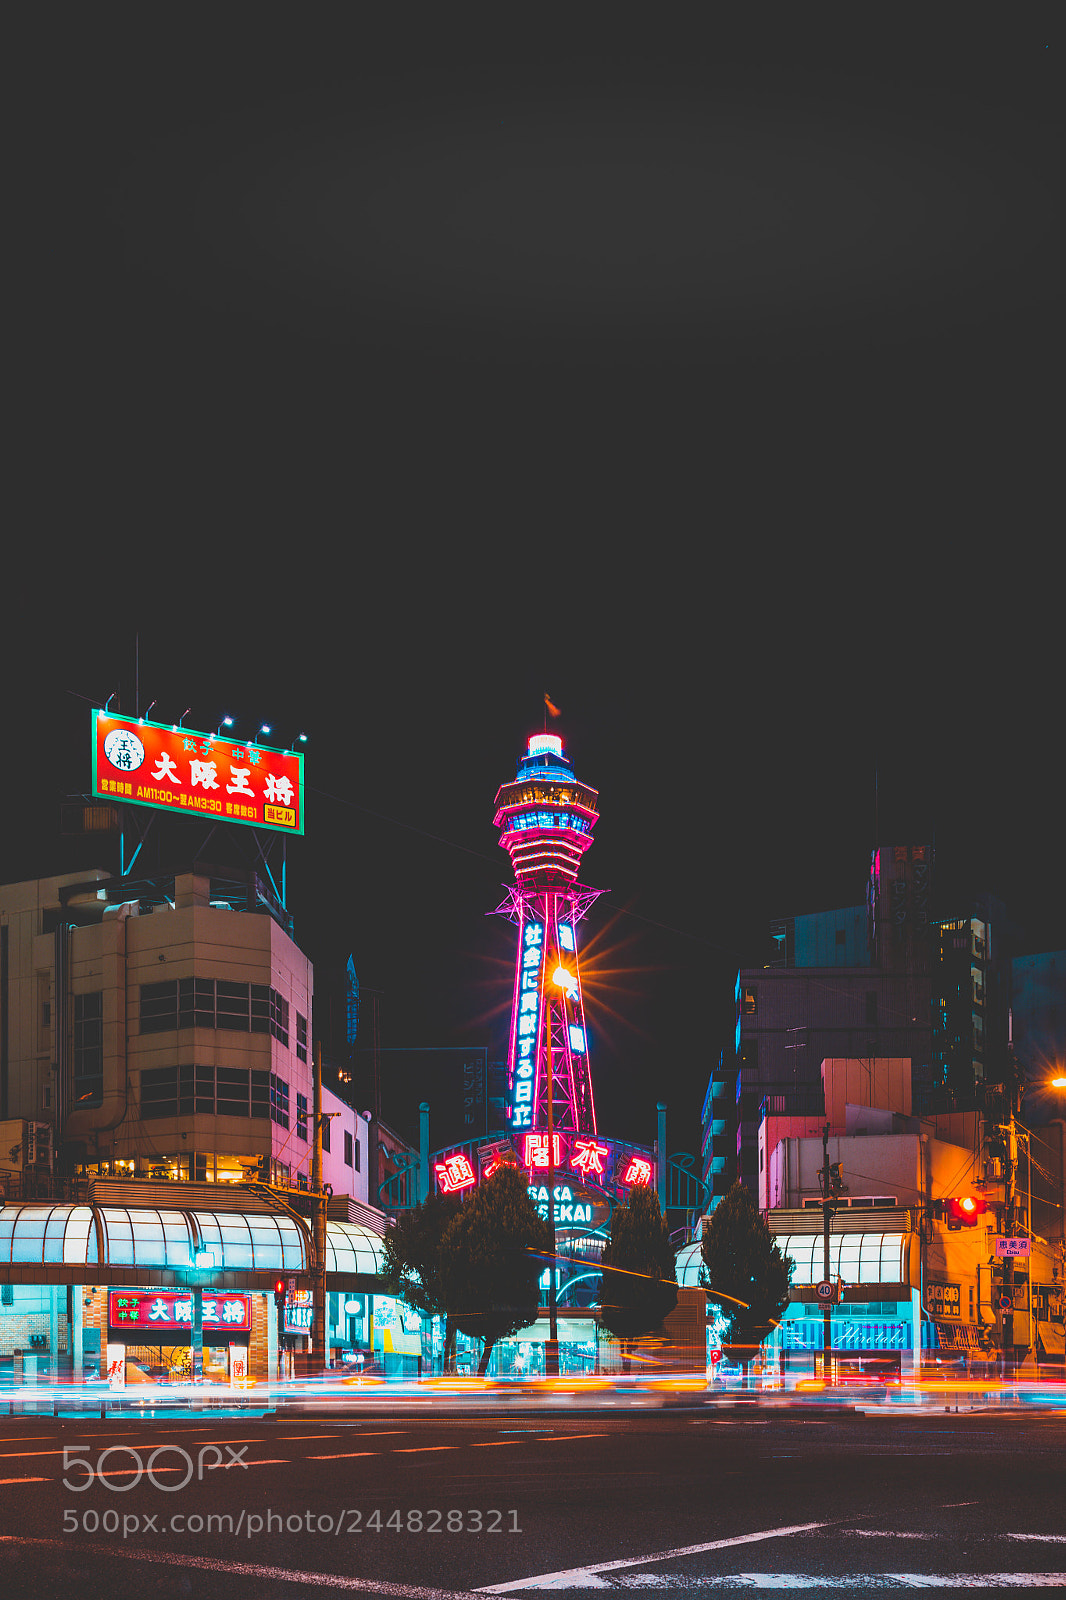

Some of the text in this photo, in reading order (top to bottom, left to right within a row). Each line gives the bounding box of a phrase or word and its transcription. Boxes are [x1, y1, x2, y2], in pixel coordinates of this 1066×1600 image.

[115, 739, 133, 769] 王将
[183, 737, 262, 766] 餃子 中華
[151, 751, 295, 805] 大阪王将
[101, 778, 132, 796] 営業時間
[226, 802, 257, 819] 客席数61
[267, 807, 293, 822] 当ビル
[117, 1298, 140, 1308] 餃子
[819, 1285, 831, 1295] 40
[148, 1298, 246, 1324] 大阪王将
[833, 1326, 906, 1344] Hirotaka
